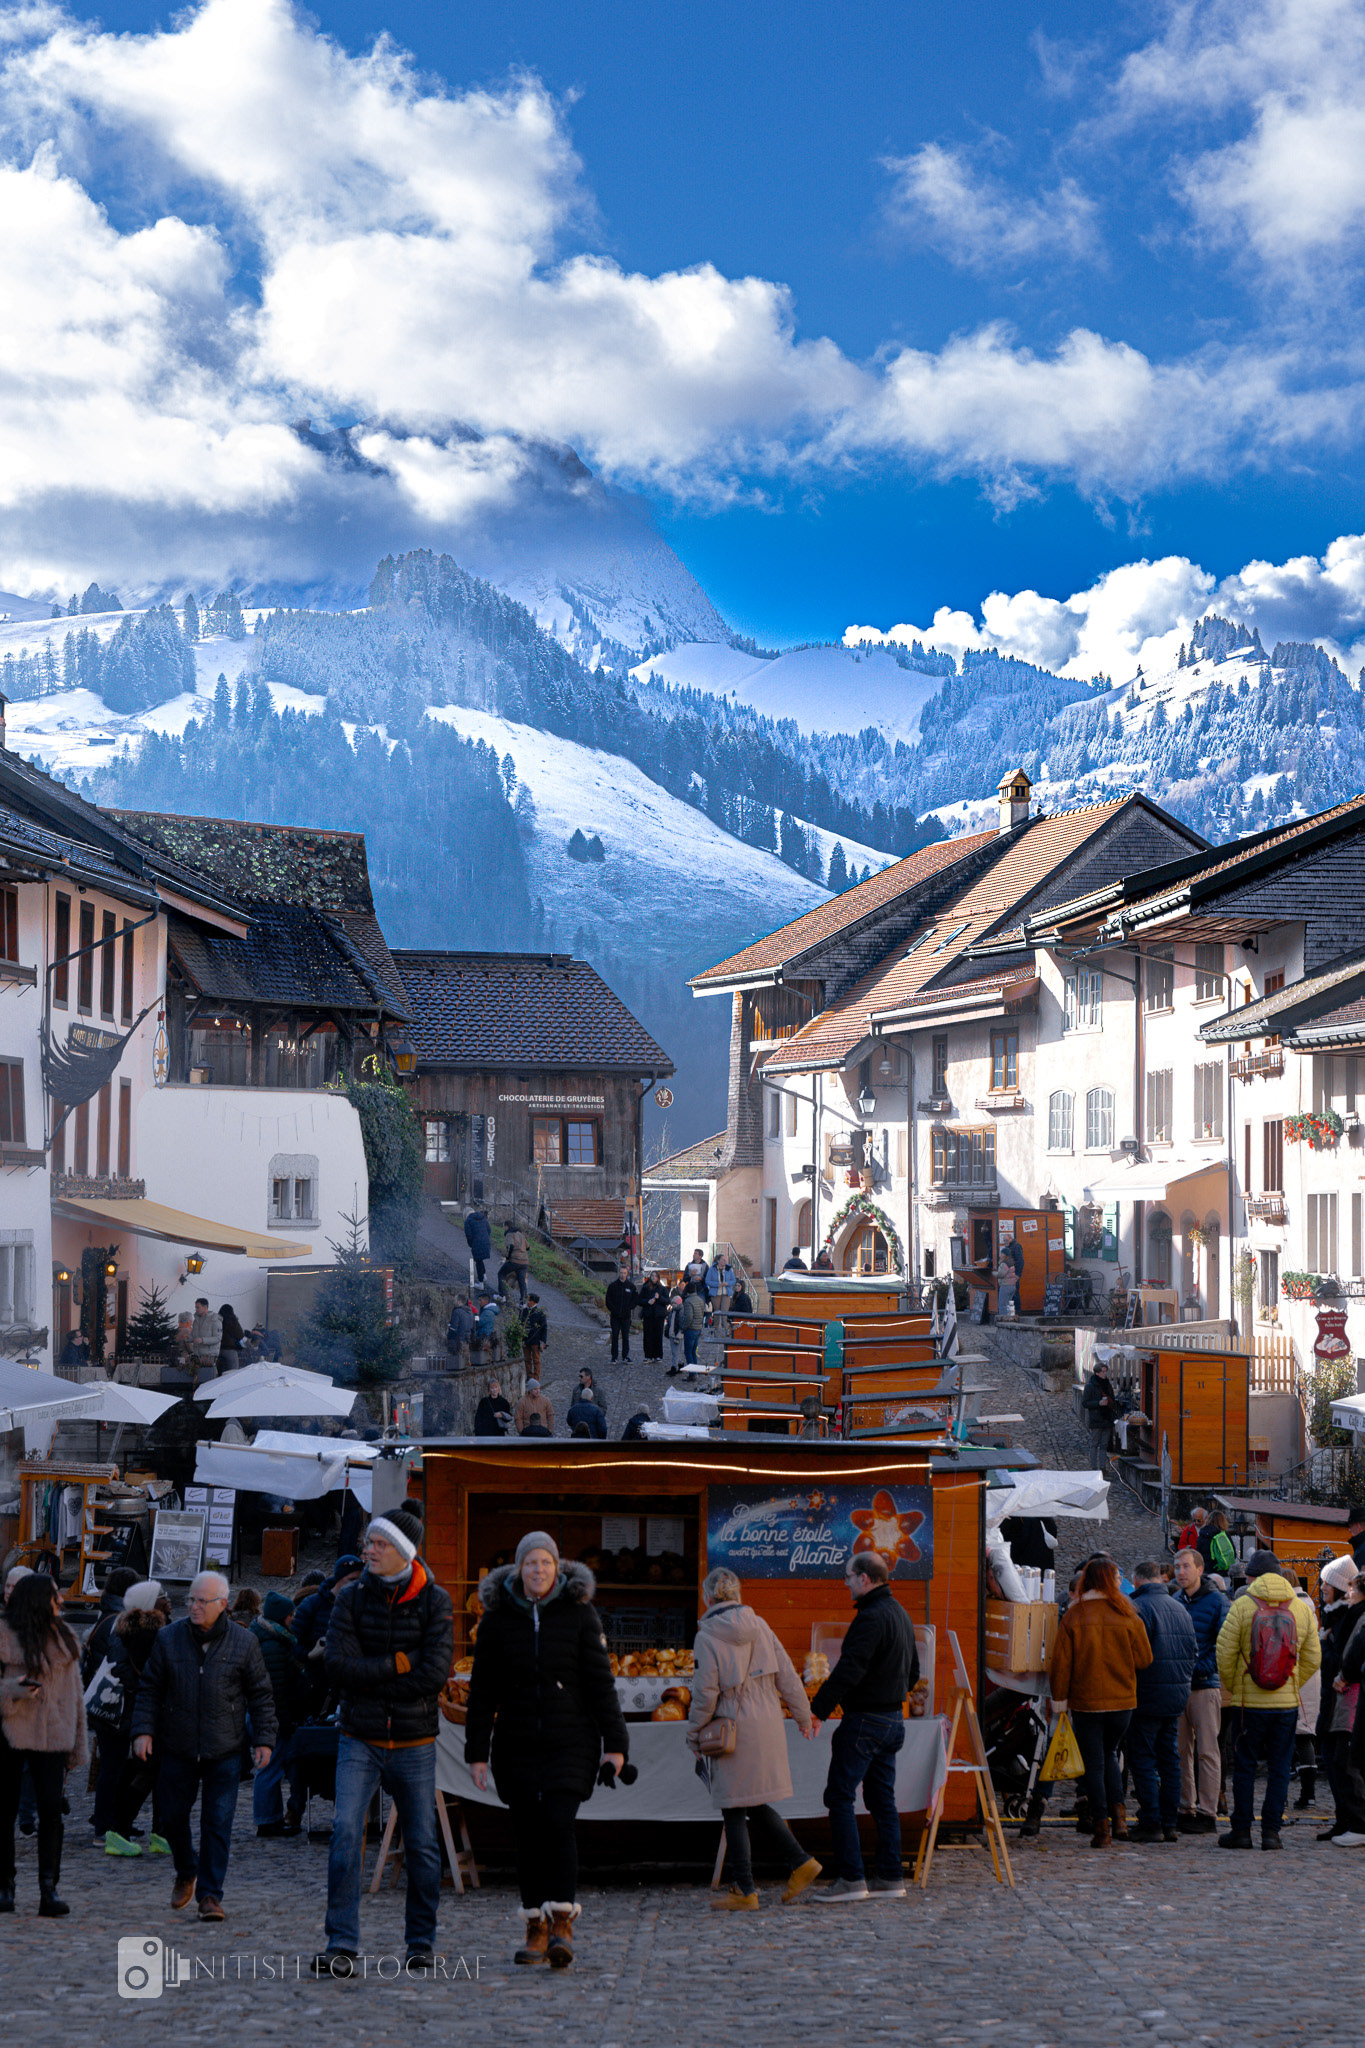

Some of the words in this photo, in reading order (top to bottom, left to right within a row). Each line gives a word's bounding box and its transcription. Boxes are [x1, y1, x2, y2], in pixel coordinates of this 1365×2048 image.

[498, 1094, 554, 1102] CHOCOLATERIE
[567, 1095, 605, 1103] GRUYÈRES
[487, 1116, 496, 1167] OUVERT
[847, 1331, 856, 1339] 15
[1160, 1376, 1168, 1384] 11
[1198, 1381, 1205, 1389] 11
[854, 1416, 864, 1425] 16
[728, 1503, 779, 1527] Prenez
[720, 1522, 737, 1542] la
[740, 1524, 789, 1542] bonne
[793, 1523, 833, 1542] étoile
[728, 1547, 751, 1557] avant
[775, 1548, 789, 1557] soit
[789, 1544, 848, 1573] filante
